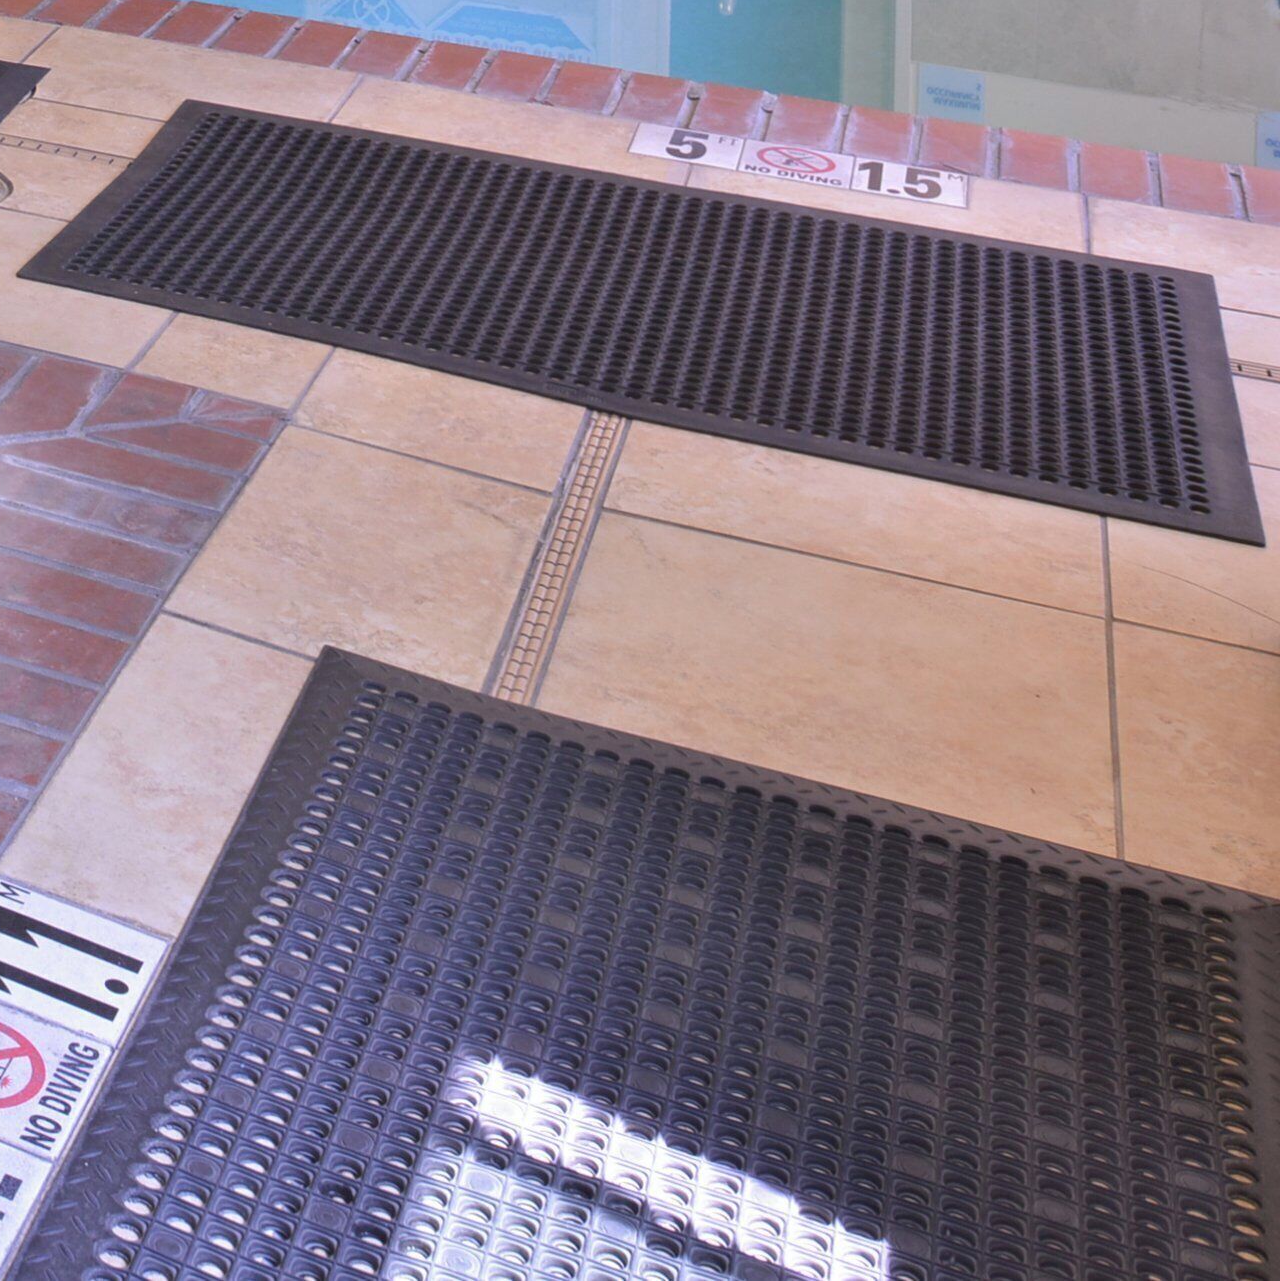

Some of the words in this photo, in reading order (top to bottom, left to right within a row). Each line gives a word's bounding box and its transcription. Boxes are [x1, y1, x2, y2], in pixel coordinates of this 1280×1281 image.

[665, 128, 709, 159] 5
[717, 136, 739, 147] FT
[744, 163, 772, 175] NO
[777, 169, 842, 187] DIVING
[858, 160, 942, 200] 1.5
[948, 174, 964, 183] M
[20, 1112, 62, 1151] NO
[48, 1041, 100, 1114] DIVING
